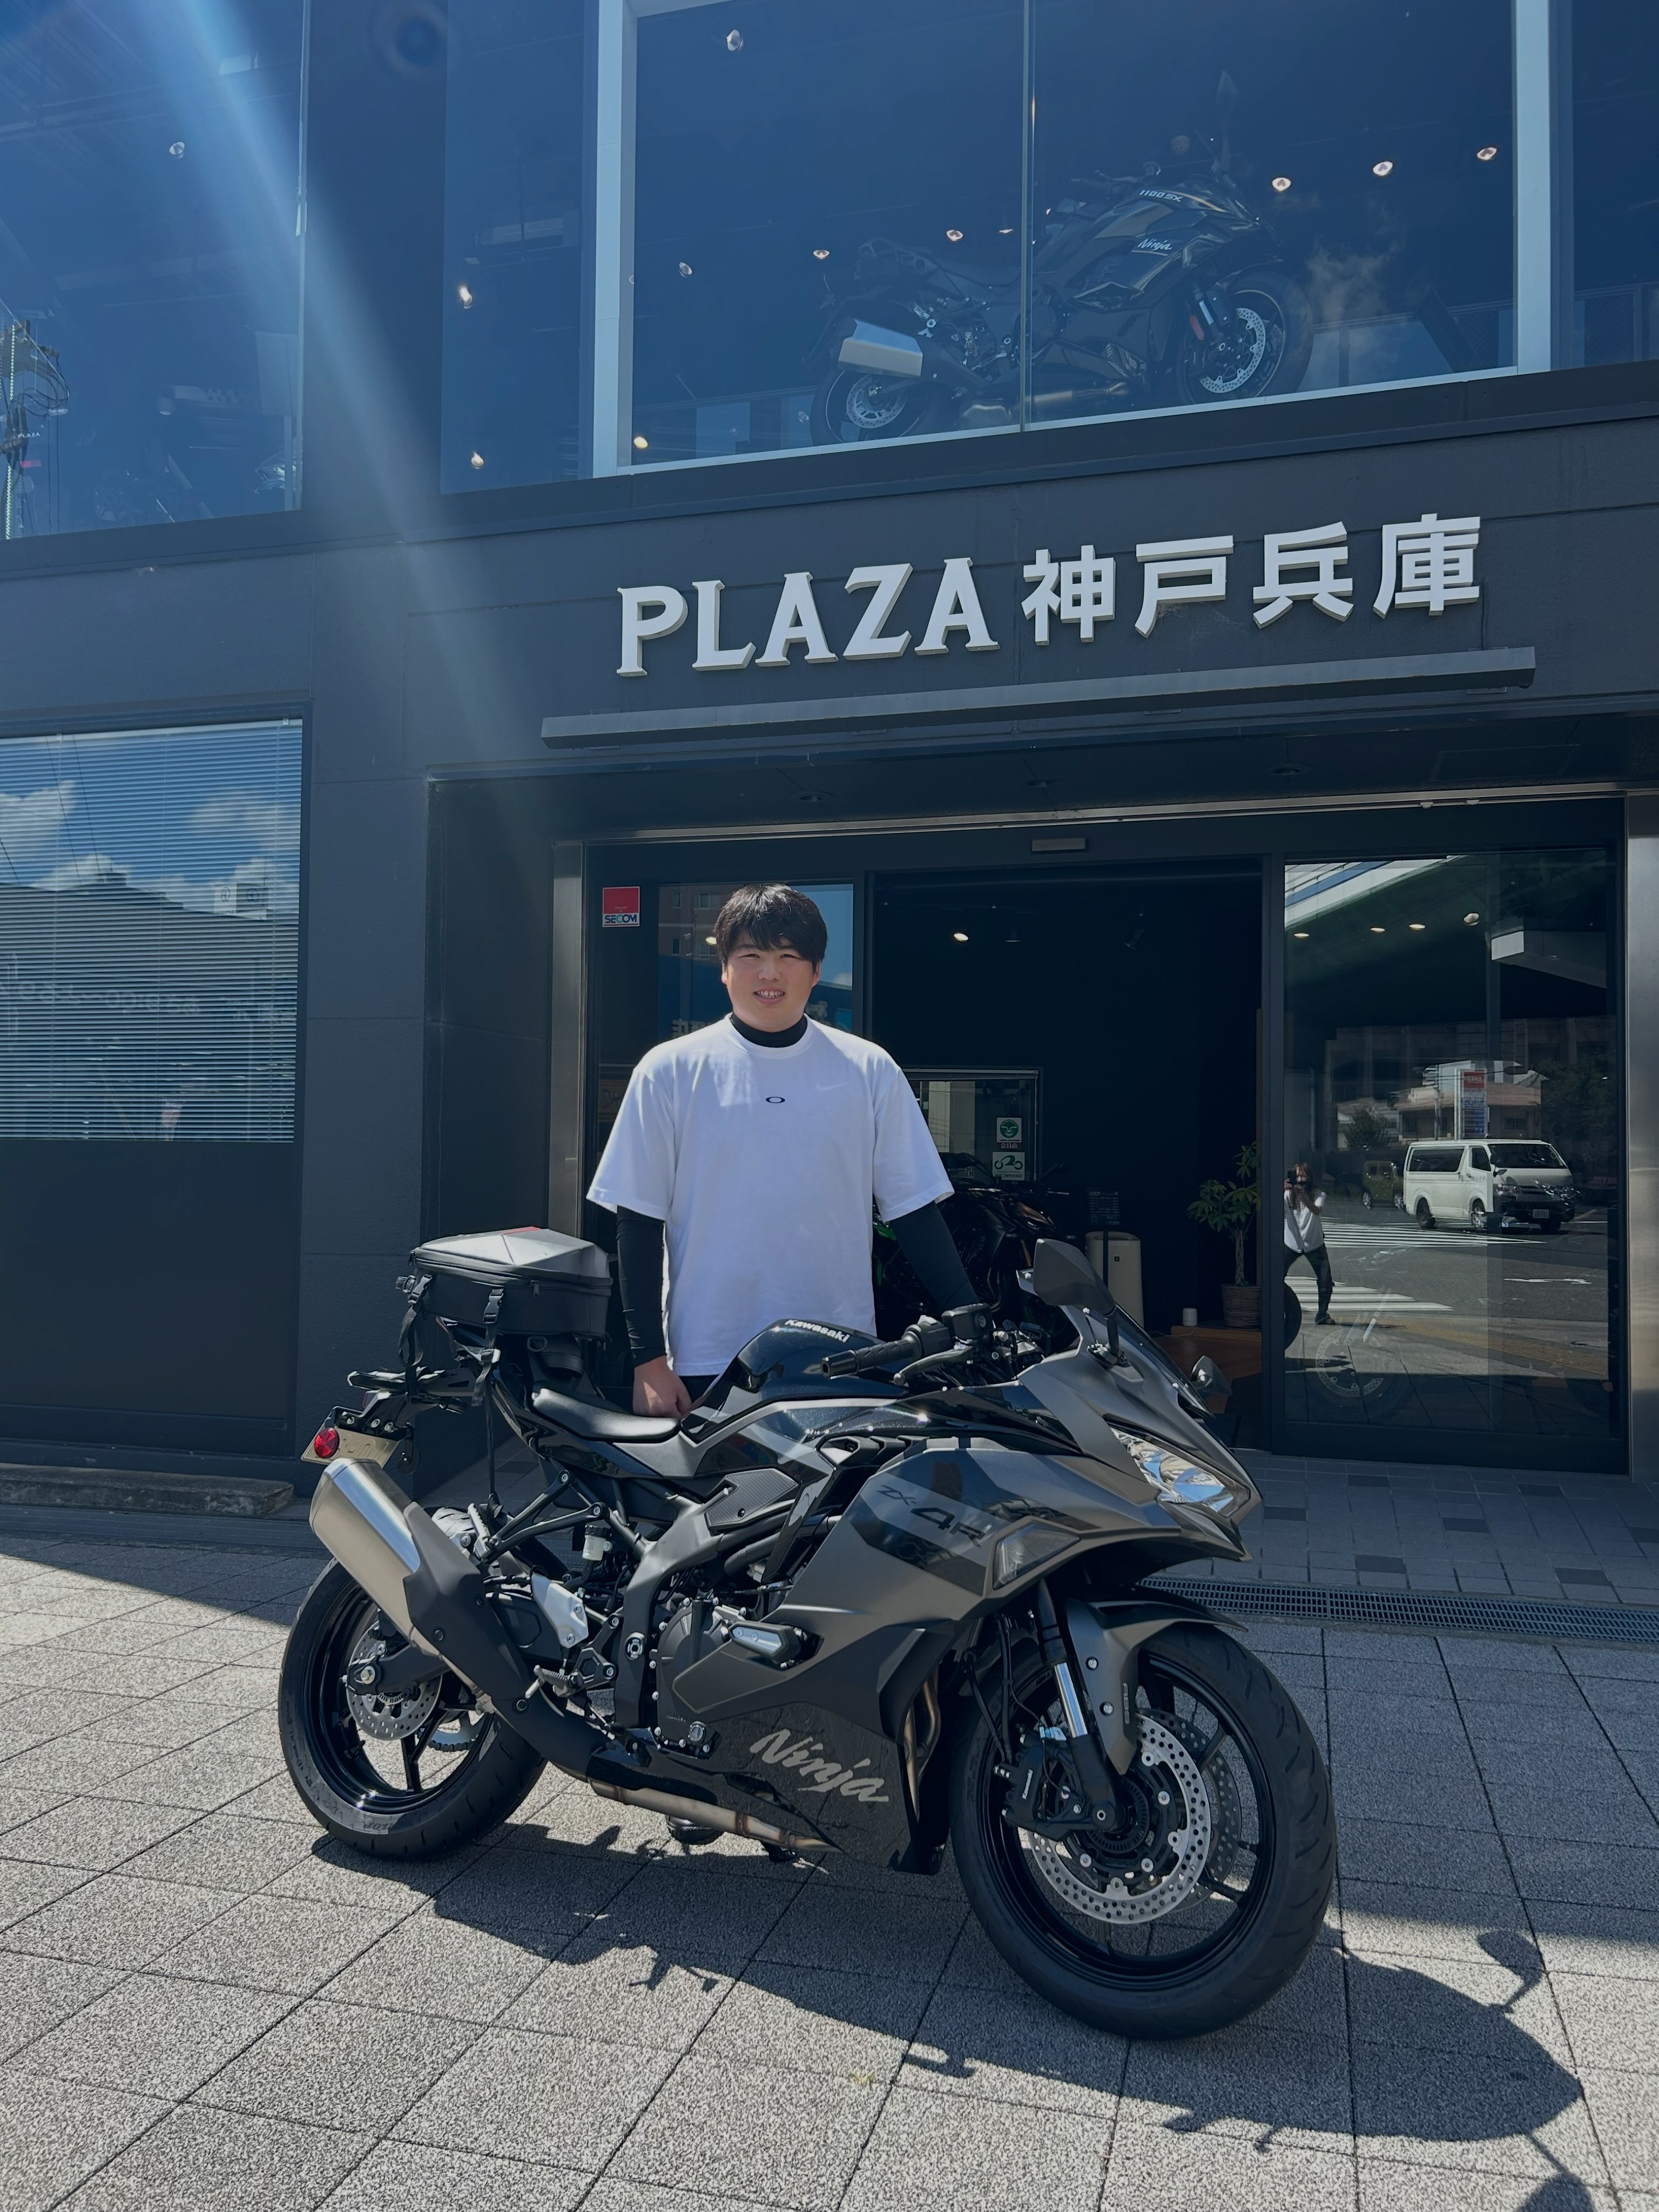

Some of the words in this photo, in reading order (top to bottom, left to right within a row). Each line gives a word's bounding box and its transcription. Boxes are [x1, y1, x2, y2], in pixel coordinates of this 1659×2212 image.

[1137, 238, 1172, 251] Ninja
[616, 557, 1000, 677] PLAZA
[1021, 513, 1481, 645] 神戸兵庫
[605, 914, 637, 923] SECOM
[784, 1319, 851, 1343] Kawasaki
[750, 1729, 889, 1802] Ninja
